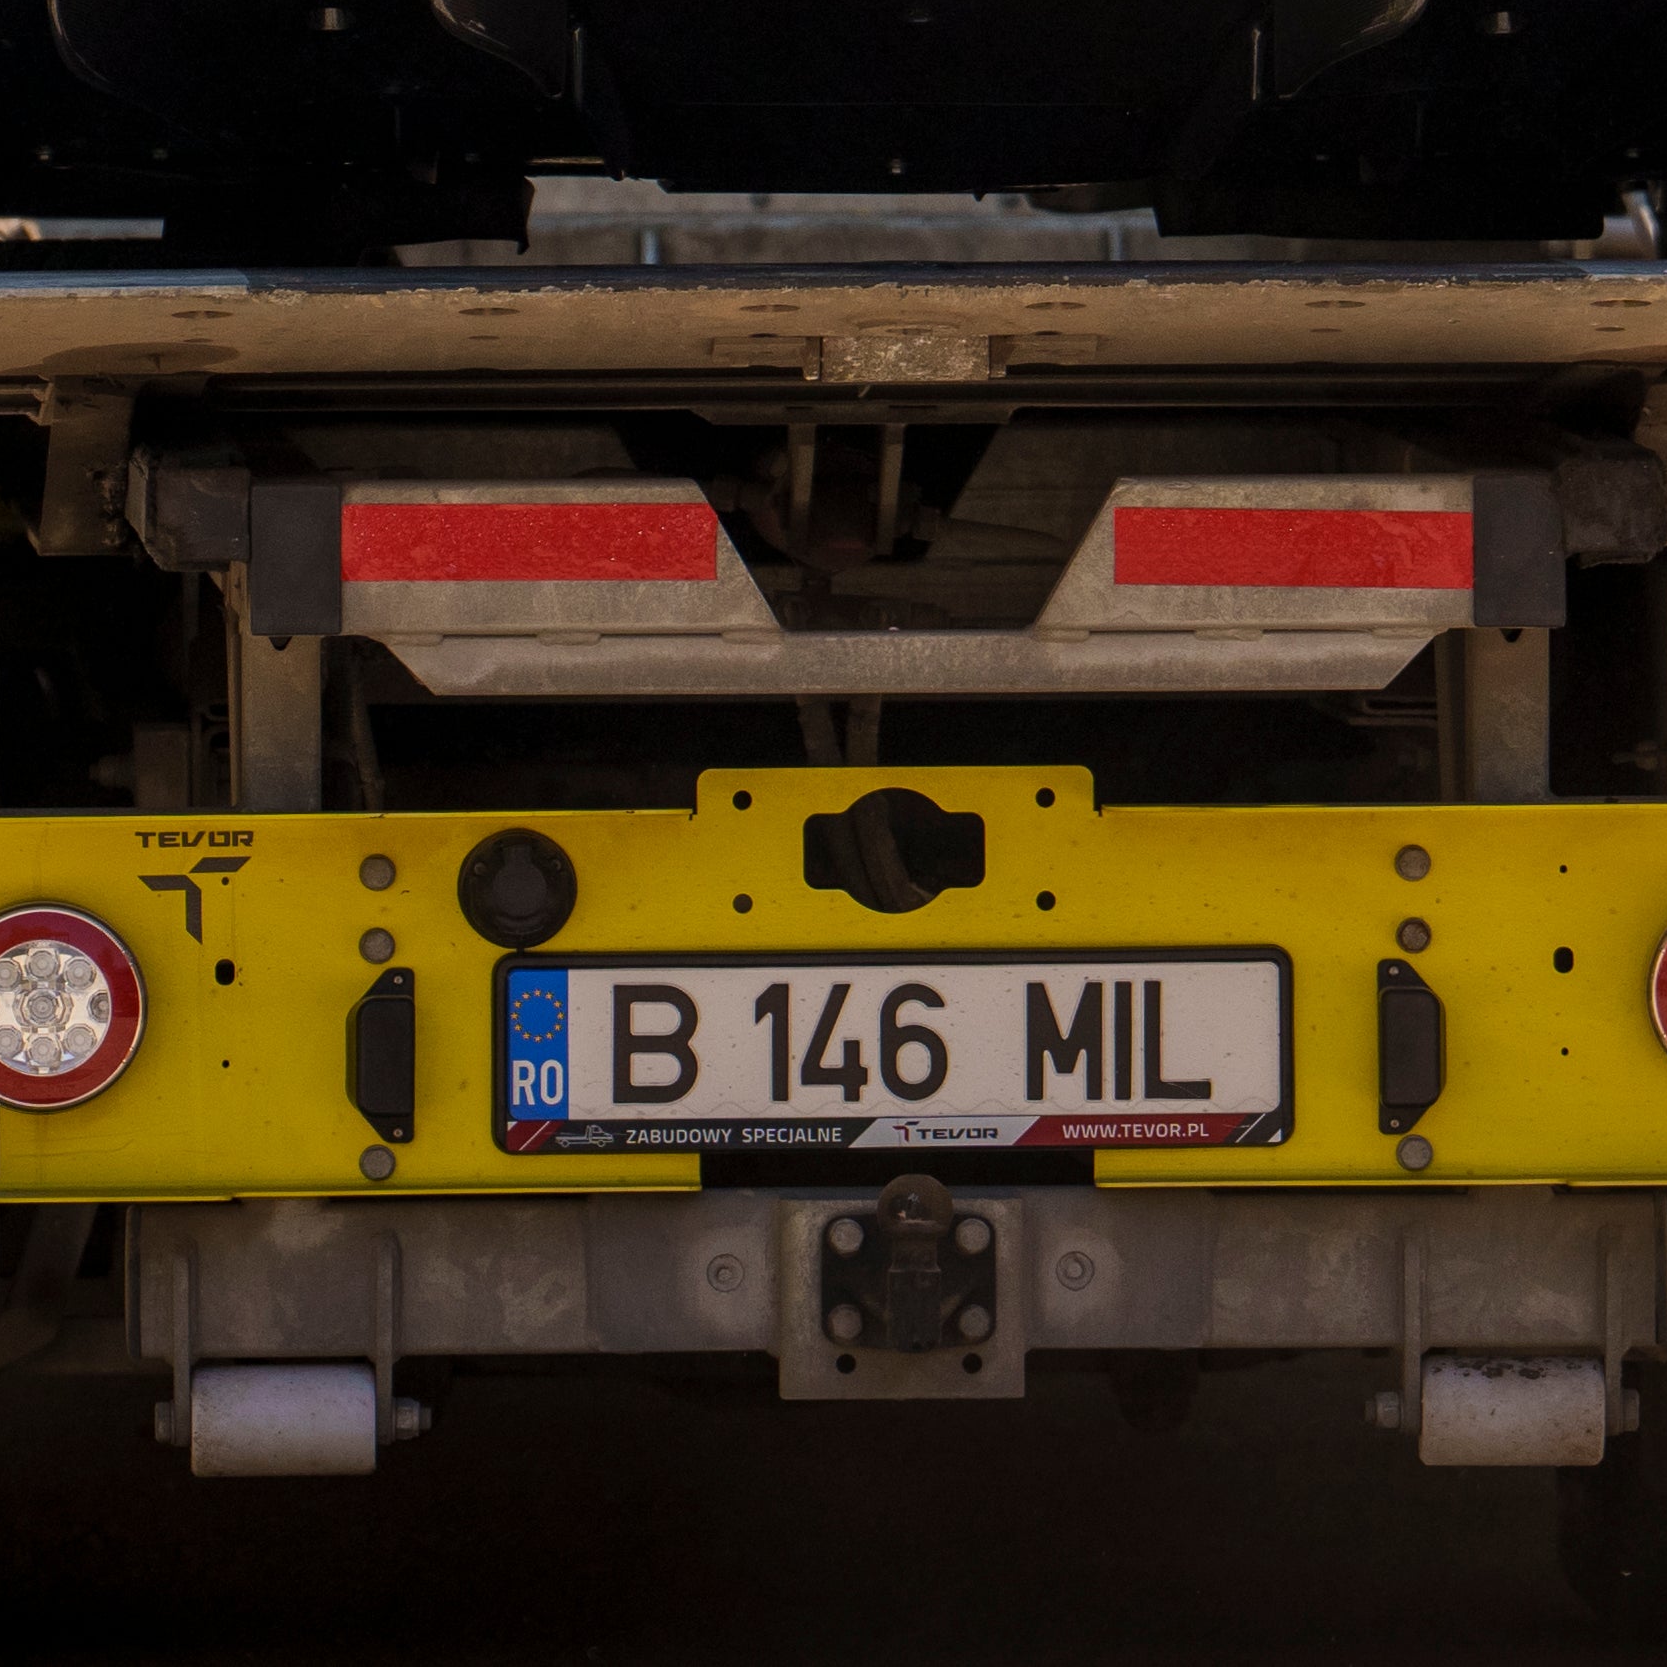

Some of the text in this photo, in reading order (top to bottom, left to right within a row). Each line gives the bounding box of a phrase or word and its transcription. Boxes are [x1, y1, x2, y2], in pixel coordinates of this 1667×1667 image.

[135, 830, 254, 848] TEVOR
[612, 980, 1213, 1105] B 146 MIL
[511, 1059, 564, 1107] RO
[625, 1127, 843, 1145] ZABUDOWY SPECJALNE
[915, 1127, 999, 1140] TEVOR
[1062, 1122, 1209, 1140] WWW.TEVOR.PL
